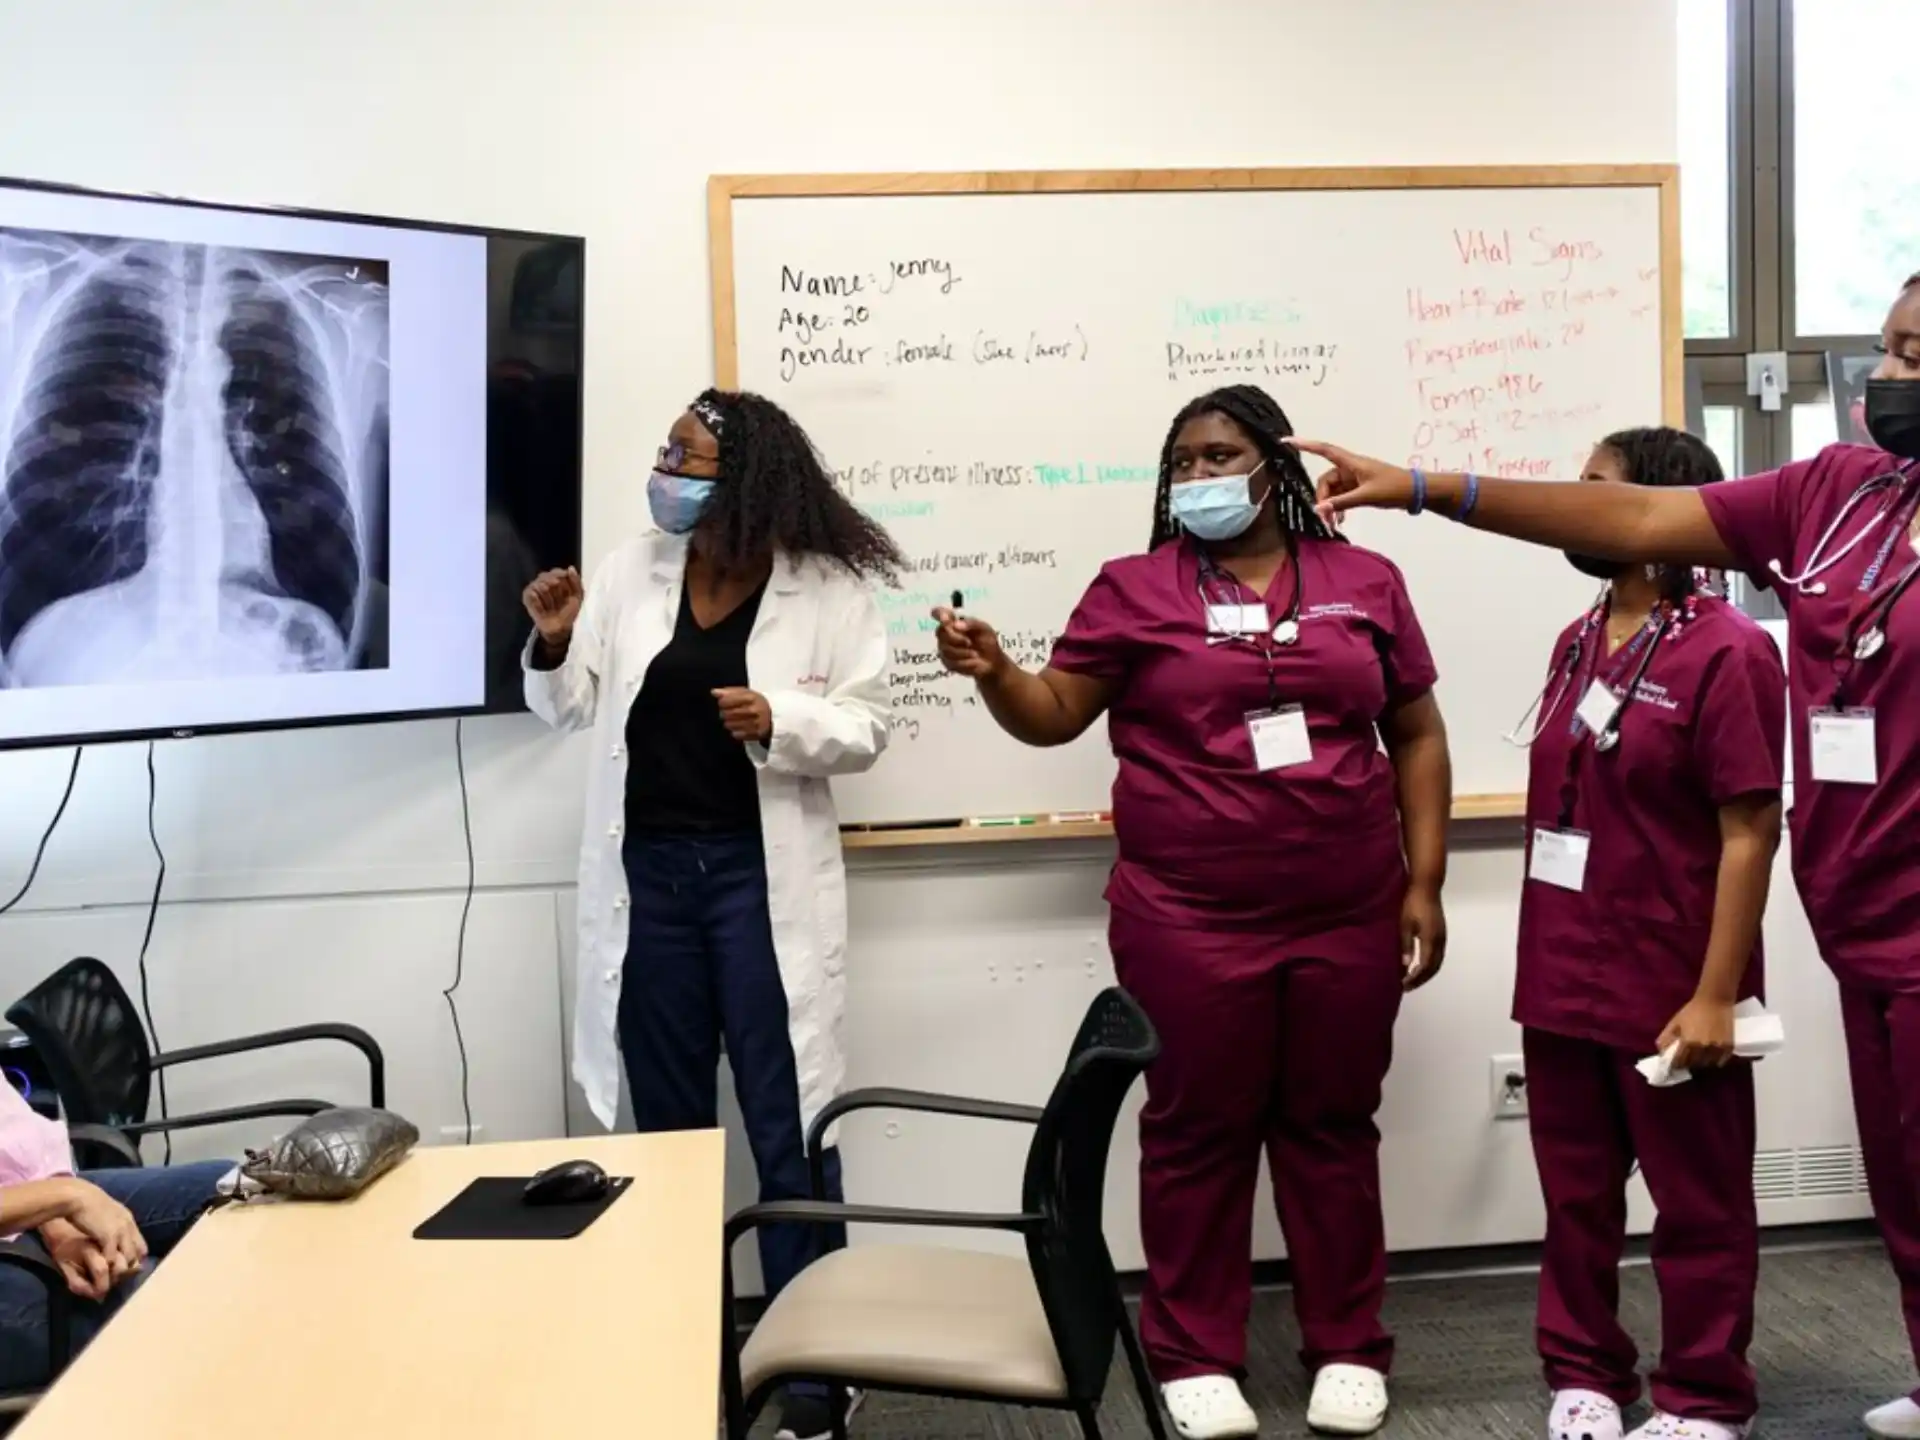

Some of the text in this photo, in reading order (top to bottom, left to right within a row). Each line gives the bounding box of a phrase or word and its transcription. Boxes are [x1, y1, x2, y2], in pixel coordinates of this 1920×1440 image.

[1453, 228, 1512, 266] Vital
[843, 304, 870, 327] 20
[859, 461, 883, 487] of
